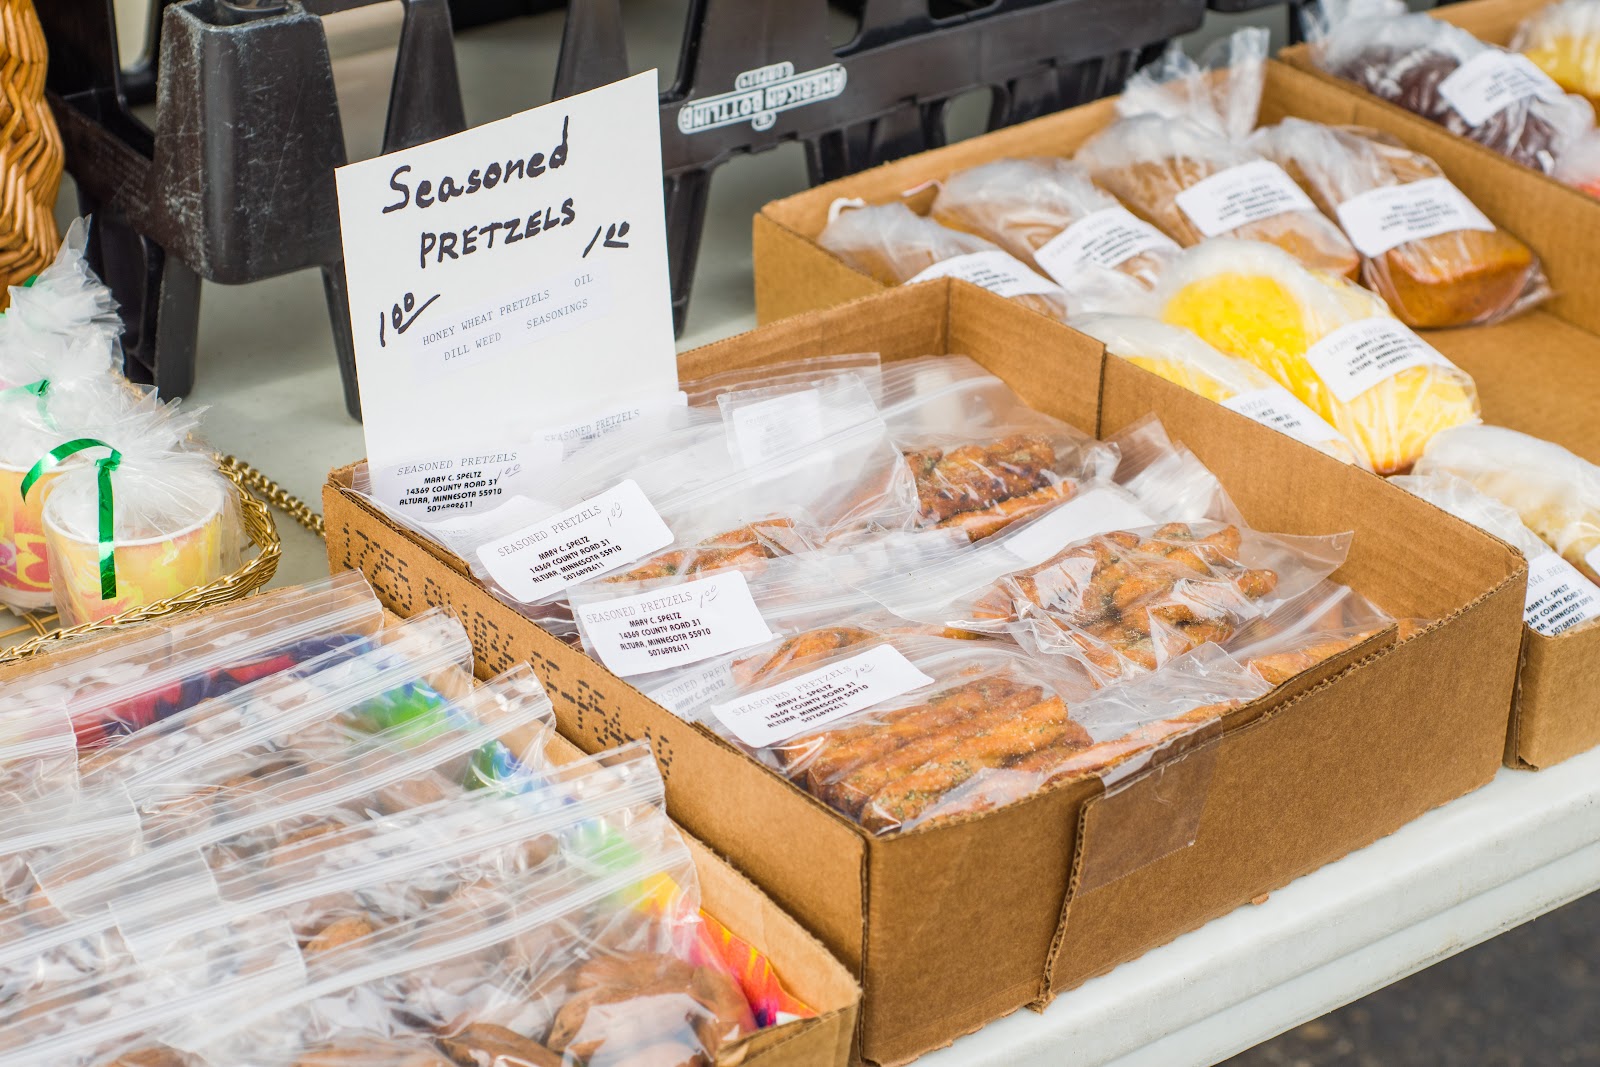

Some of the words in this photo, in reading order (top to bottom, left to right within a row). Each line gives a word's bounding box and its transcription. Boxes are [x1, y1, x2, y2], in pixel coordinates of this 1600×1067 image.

[766, 67, 842, 109] AMERICAN
[682, 89, 763, 129] BOTTLING
[382, 115, 569, 214] Seasoned
[420, 198, 575, 268] PRETZELS
[423, 326, 455, 345] HONEY
[461, 311, 493, 331] WHEAT
[500, 289, 550, 316] PRETZELS
[574, 273, 593, 287] OIL
[444, 344, 470, 361] DILL
[476, 332, 501, 348] WEED
[526, 298, 588, 329] SEASONINGS
[544, 425, 591, 441] SEASONED
[596, 409, 639, 430] PRETZELS
[397, 460, 453, 475] SEASONED
[461, 452, 517, 467] PRETZELS
[406, 487, 429, 495] 14369
[432, 483, 461, 493] COUNTY
[464, 480, 486, 488] ROAD
[424, 476, 446, 484] MARY
[456, 471, 482, 479] SPELTZ
[399, 497, 430, 505] ALTURA,
[432, 491, 477, 503] MINNESOTA
[479, 488, 502, 497] 55910
[497, 530, 548, 557] SEASONED
[551, 505, 602, 533] PRETZELS
[530, 561, 551, 574] 14369
[552, 552, 579, 565] COUNTY
[580, 543, 600, 554] ROAD
[538, 548, 558, 560] MARY
[566, 536, 590, 550] SPELTZ
[532, 570, 561, 583] ALTURA,
[561, 553, 600, 573] MINNESOTA
[599, 545, 622, 558] 55910
[563, 562, 605, 581] 5076892611
[586, 606, 636, 624] SEASONED
[640, 591, 693, 613] PRETZELS
[1526, 599, 1544, 613] MARY
[1551, 584, 1569, 597] SPELTZ
[1540, 599, 1563, 616] COUNTY
[1563, 591, 1578, 603] ROAD
[629, 618, 648, 627] MARY
[657, 612, 682, 622] SPELTZ
[1548, 603, 1579, 624] MINNESOTA
[619, 630, 640, 639] 14369
[641, 625, 668, 636] COUNTY
[670, 621, 691, 631] ROAD
[692, 618, 702, 626] 31
[620, 641, 648, 651] ALTURA,
[648, 634, 688, 646] MINNESOTA
[688, 628, 711, 638] 55910
[648, 643, 690, 656] 5076892611
[702, 679, 726, 695] SPELTZ
[732, 691, 790, 716] SEASONED
[795, 665, 852, 693] PRETZELS
[764, 708, 789, 720] 14369
[790, 697, 820, 711] COUNTY
[822, 687, 845, 699] ROAD
[845, 681, 856, 689] 31
[775, 697, 797, 709] MARY
[807, 684, 833, 697] SPELTZ
[767, 715, 800, 728] ALTURA,
[799, 696, 843, 716] MINNESOTA
[844, 684, 869, 697] 55910
[801, 702, 848, 723] 5076892611
